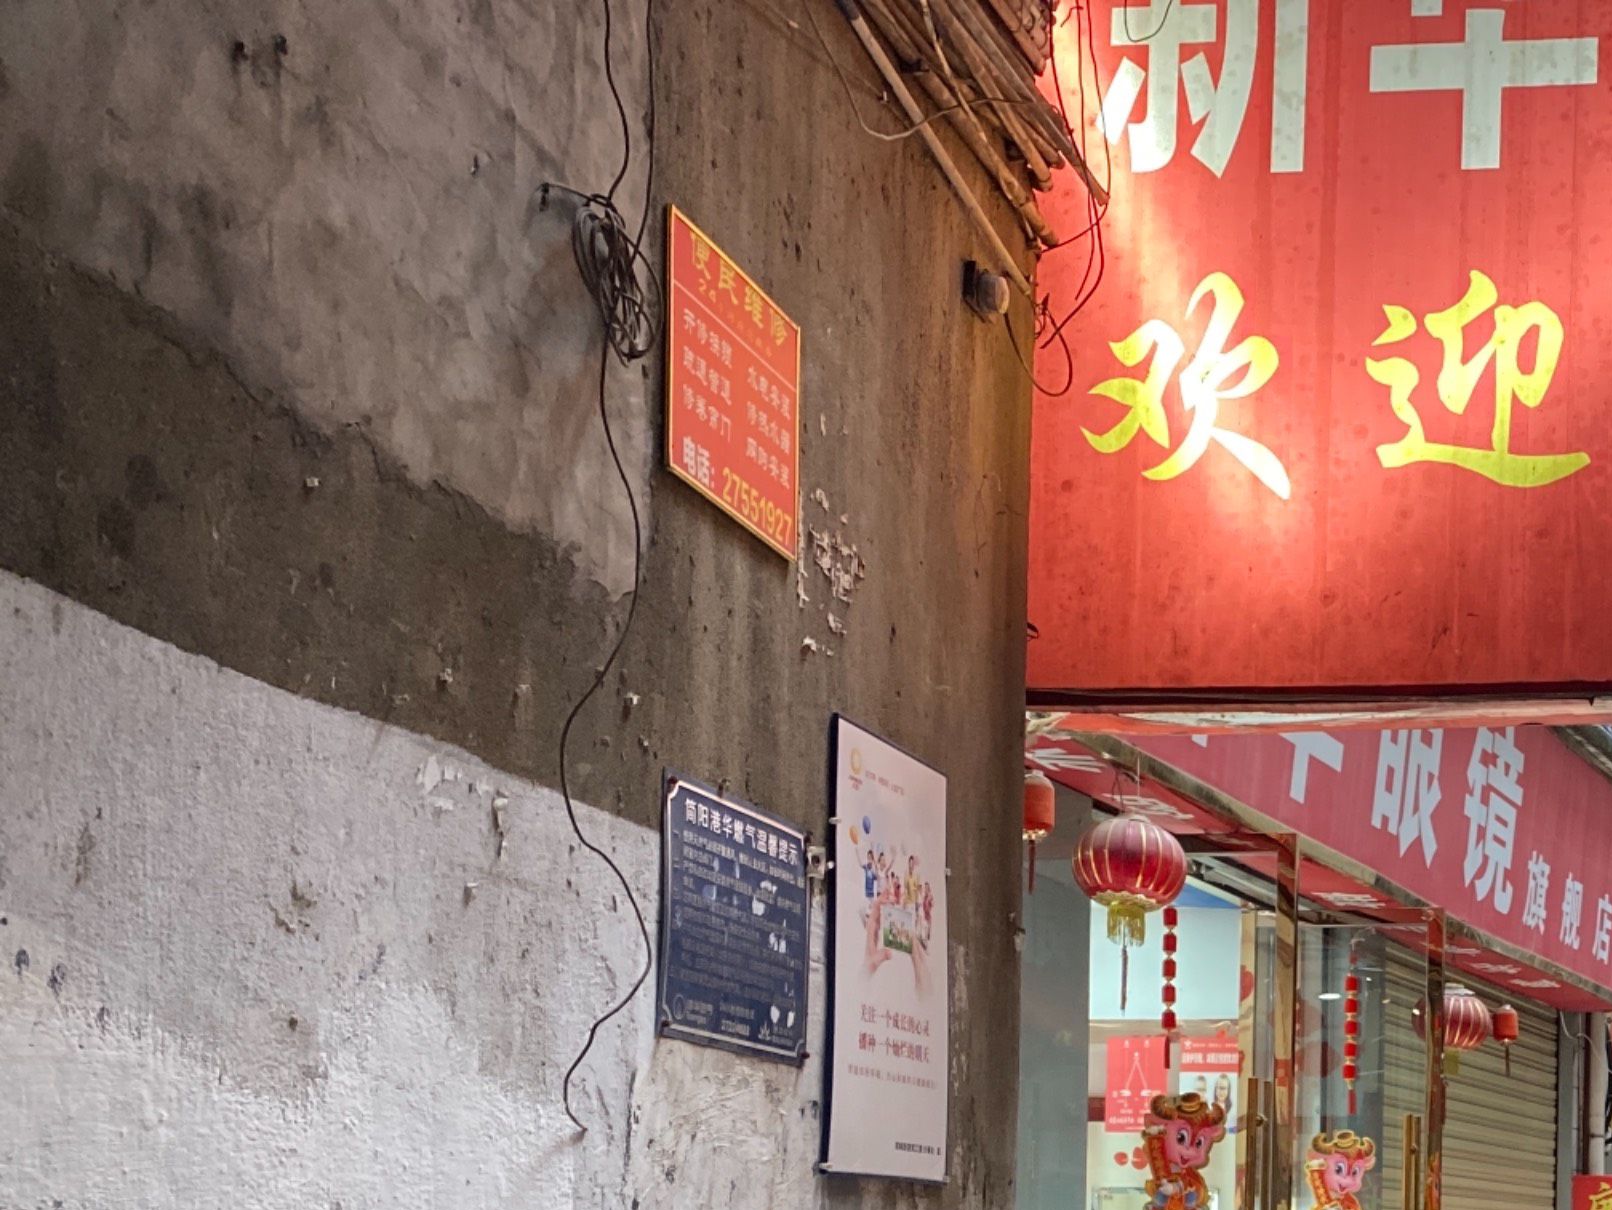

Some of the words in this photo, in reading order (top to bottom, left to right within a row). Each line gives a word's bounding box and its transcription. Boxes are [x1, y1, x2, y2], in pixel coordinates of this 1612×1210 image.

[688, 229, 789, 347] 便民维修
[721, 465, 794, 547] 27551927
